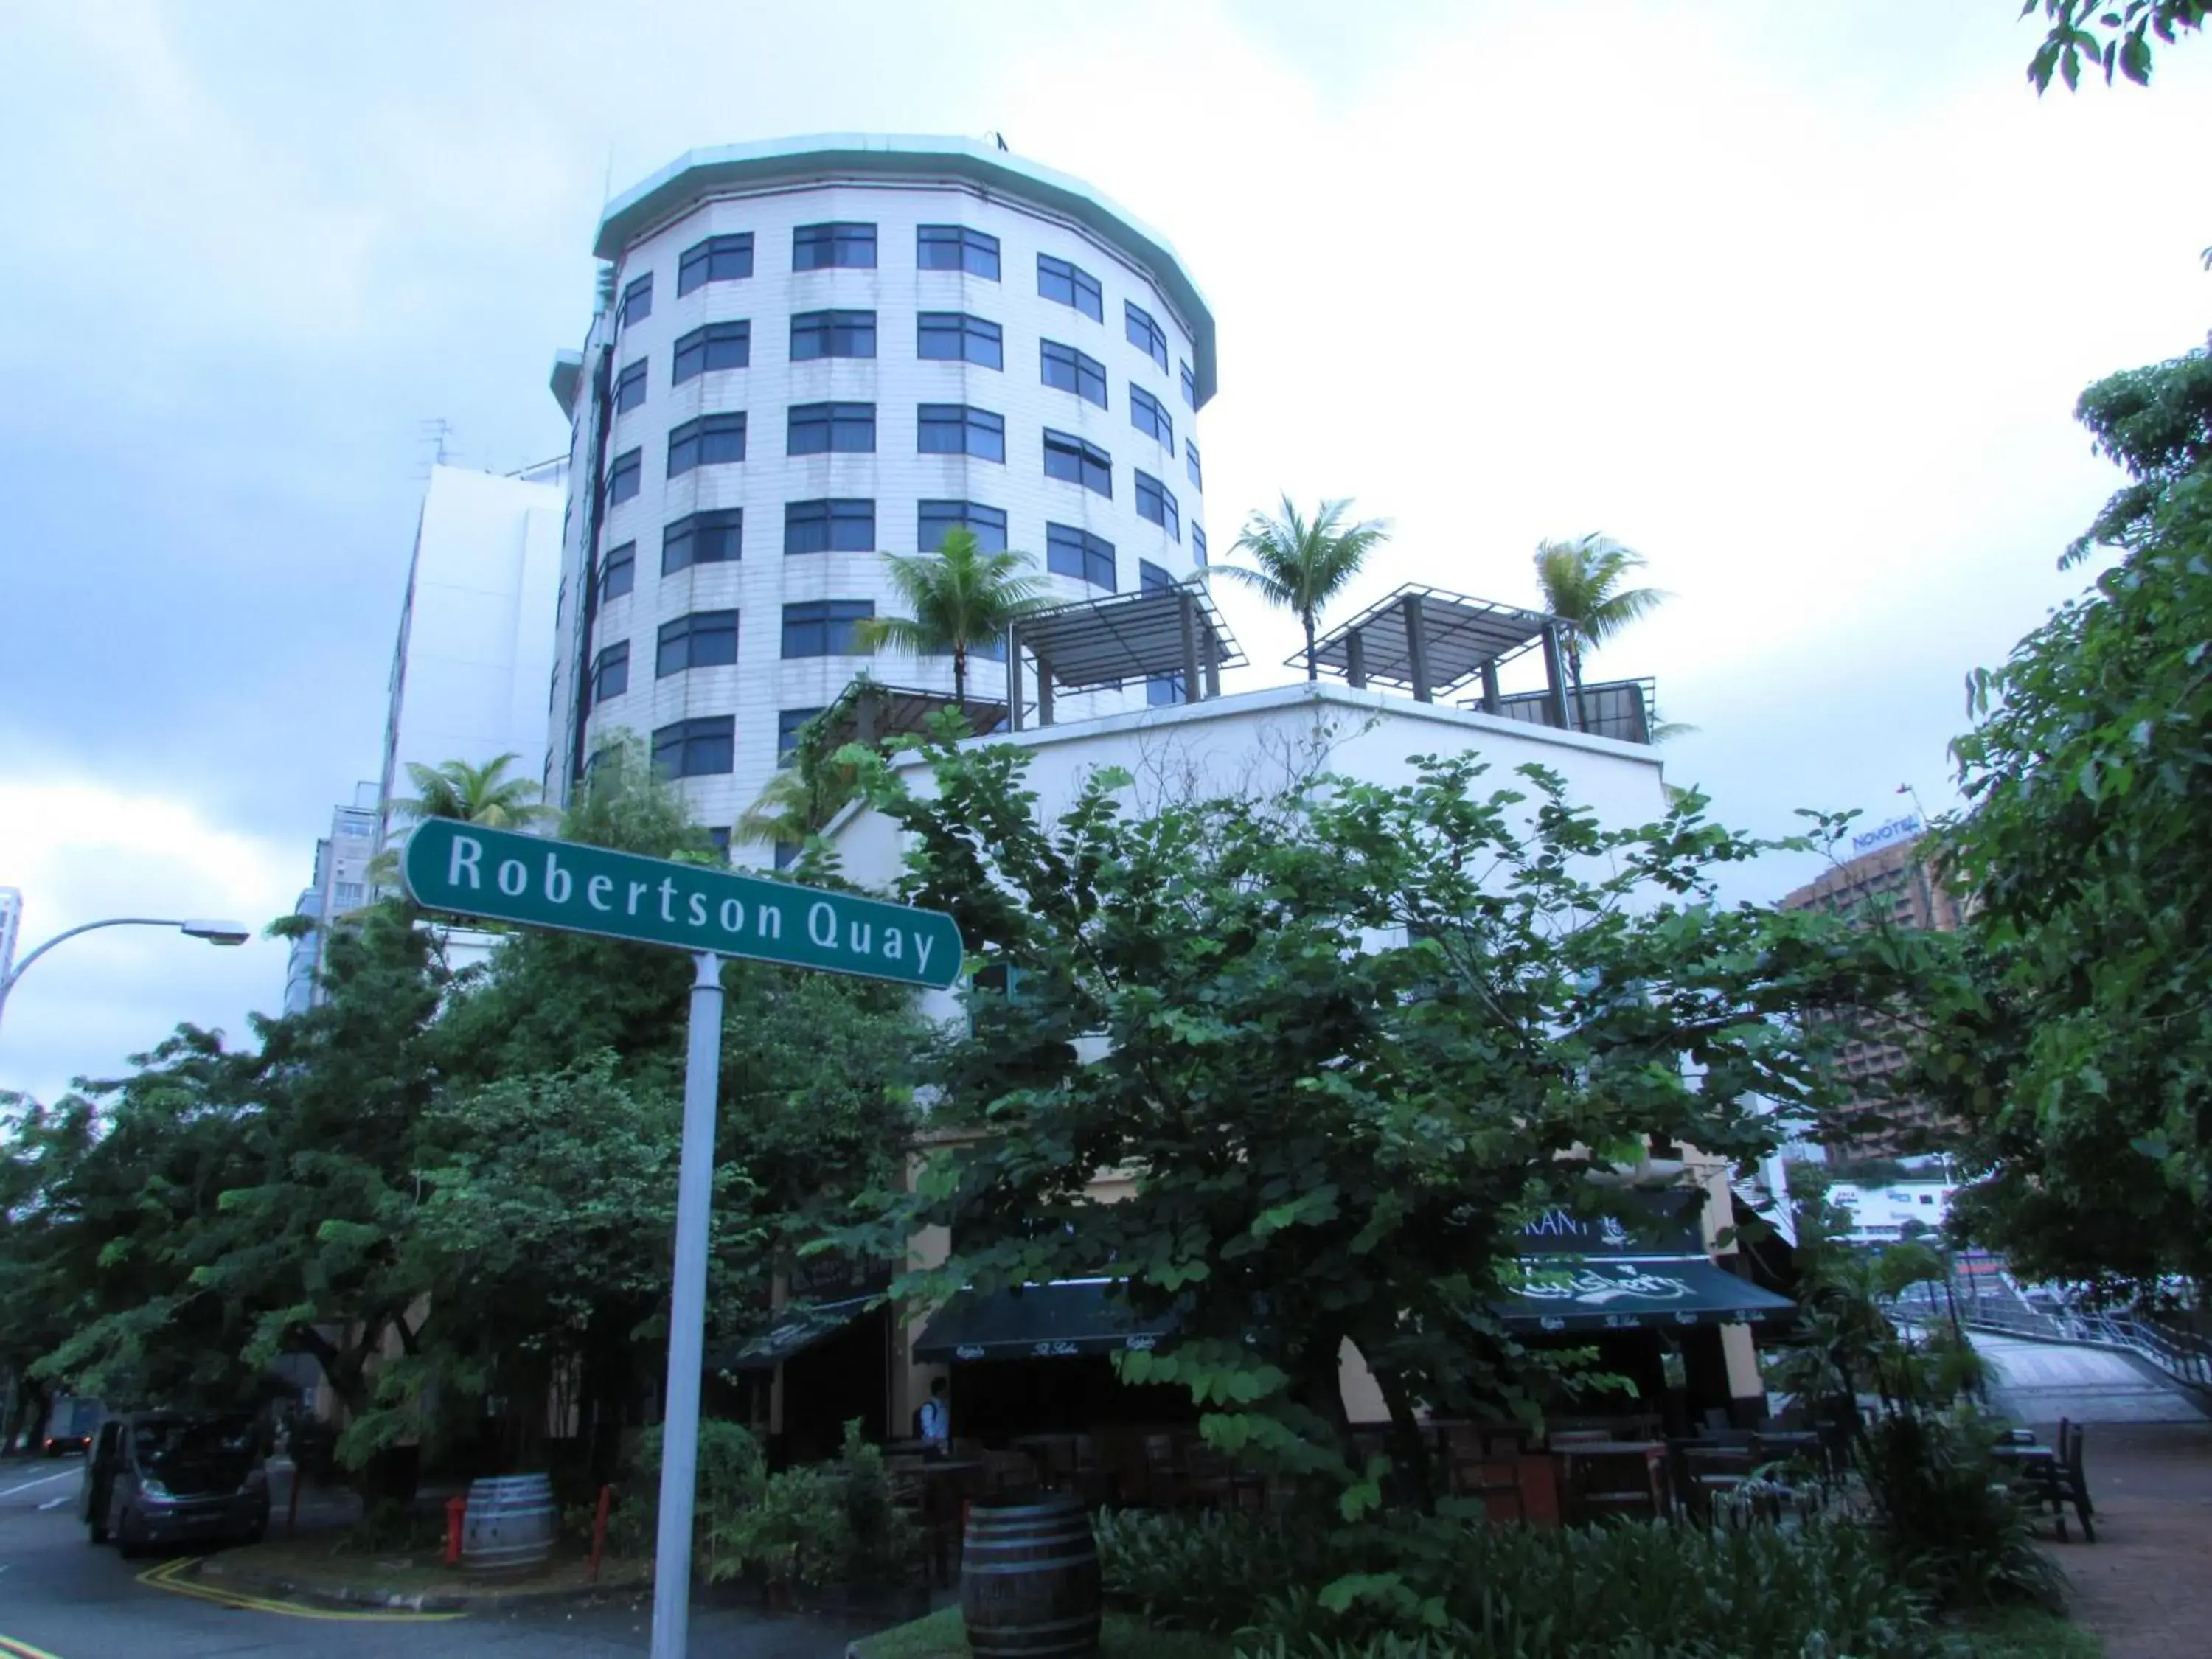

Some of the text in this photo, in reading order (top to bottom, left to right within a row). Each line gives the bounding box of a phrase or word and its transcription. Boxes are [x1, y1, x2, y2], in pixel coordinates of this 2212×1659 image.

[1852, 815, 1919, 849] NOVOTEL
[448, 835, 935, 975] Robertson Quay
